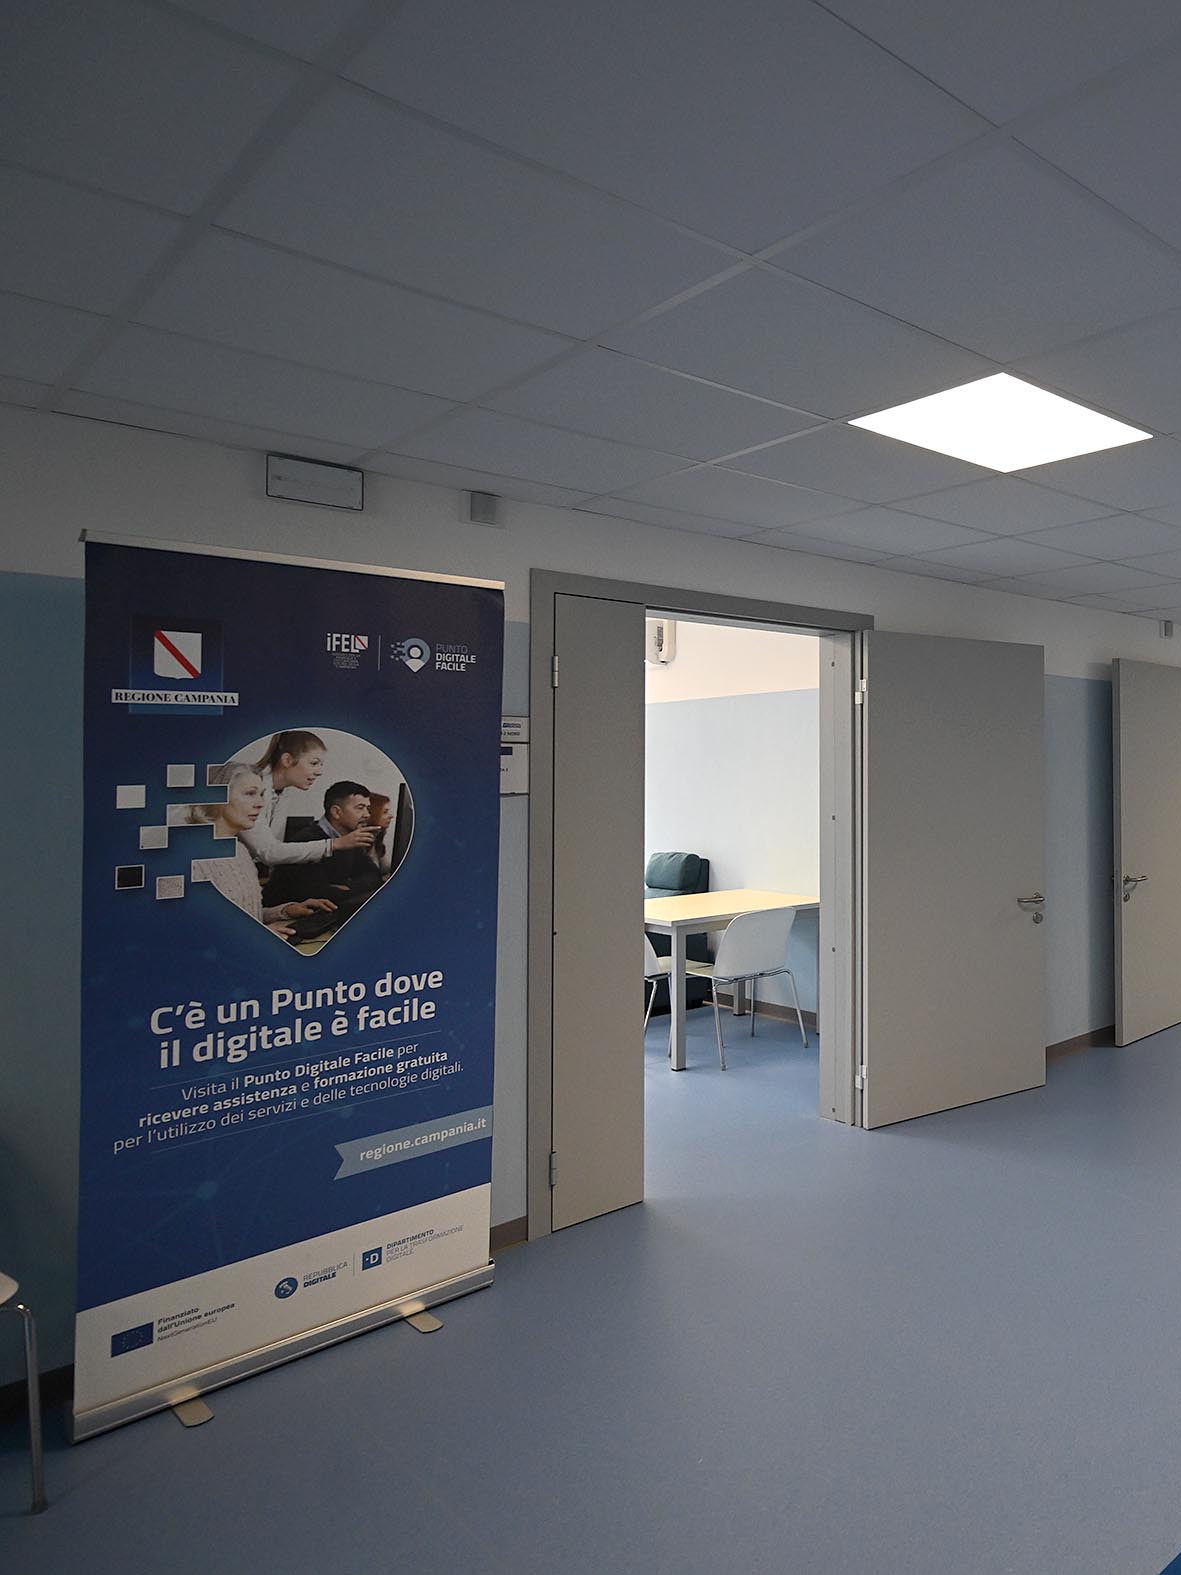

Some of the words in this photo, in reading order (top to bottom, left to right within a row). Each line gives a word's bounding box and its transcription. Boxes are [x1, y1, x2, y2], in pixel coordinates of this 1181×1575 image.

[436, 643, 468, 654] PUNTO
[436, 652, 477, 664] DIGITALE
[436, 662, 467, 672] FACILE
[115, 692, 172, 702] REGIONE
[174, 693, 236, 704] CAMPANIA
[150, 1001, 206, 1035] C'è
[217, 999, 260, 1024] un
[272, 981, 366, 1015] Punto
[374, 970, 444, 998] dove
[160, 1040, 180, 1069] il
[192, 1018, 322, 1064] digitale
[331, 1010, 348, 1036] è
[357, 998, 436, 1032] facile
[182, 1081, 227, 1101] Visita
[231, 1078, 240, 1090] il
[244, 1068, 291, 1088] Punto
[295, 1056, 351, 1078] Digitale
[354, 1047, 394, 1065] Facile
[398, 1043, 419, 1059] per
[138, 1104, 208, 1128] ricevere
[212, 1084, 297, 1112] assistenza
[301, 1082, 310, 1092] e
[314, 1063, 393, 1090] formazione
[396, 1050, 448, 1074] gratuita
[114, 1134, 143, 1155] per
[148, 1119, 216, 1143] l'utilizzo
[220, 1110, 244, 1127] dei
[248, 1098, 296, 1120] servizi
[301, 1096, 309, 1108] e
[313, 1088, 346, 1106] delle
[350, 1071, 418, 1097] tecnologie
[421, 1061, 464, 1083] digitali.
[360, 1117, 487, 1161] regione.campania.it
[386, 1228, 434, 1250] DIPARTIMENTO
[386, 1247, 399, 1256] PER
[386, 1249, 414, 1263] DIGITALE
[303, 1261, 348, 1282] REPUBBLICA
[303, 1271, 337, 1288] DIGITALE
[158, 1307, 200, 1325] Finanziato
[158, 1314, 202, 1333] dall'Unione
[204, 1302, 236, 1318] europea
